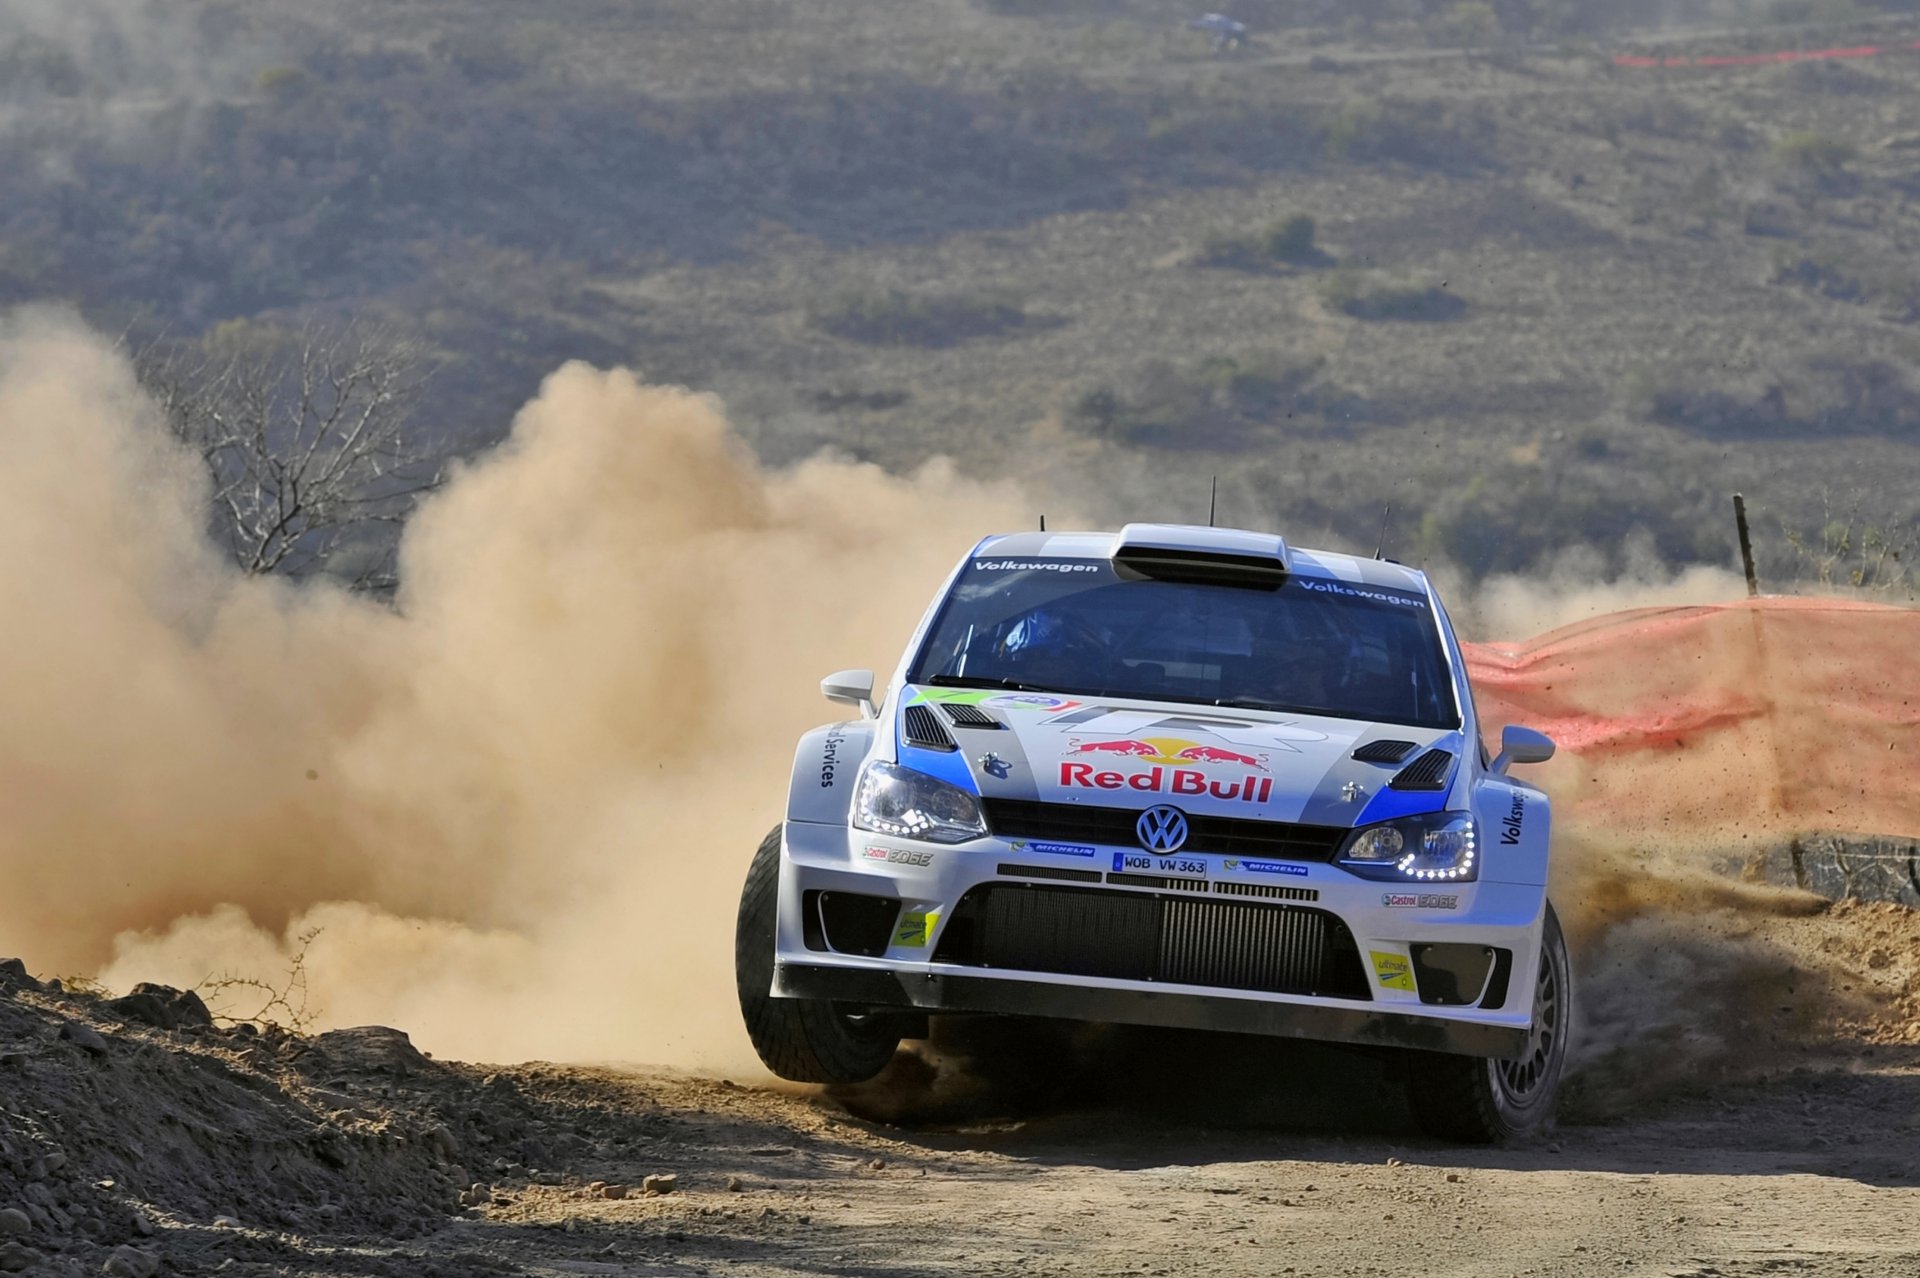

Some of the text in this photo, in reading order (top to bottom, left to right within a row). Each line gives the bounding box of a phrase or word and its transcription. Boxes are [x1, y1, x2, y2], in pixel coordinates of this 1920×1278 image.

[975, 560, 1099, 573] Volkswagen
[1298, 580, 1425, 608] Volkswagen
[821, 738, 845, 788] Services
[1061, 762, 1273, 803] Red Bull
[1138, 806, 1187, 853] VW
[1035, 844, 1094, 855] MICHELIN
[1124, 856, 1151, 869] WOB
[1159, 859, 1177, 871] VW
[1178, 860, 1205, 873] 363
[1248, 863, 1307, 874] MICHELIN
[1391, 895, 1416, 906] Castrol
